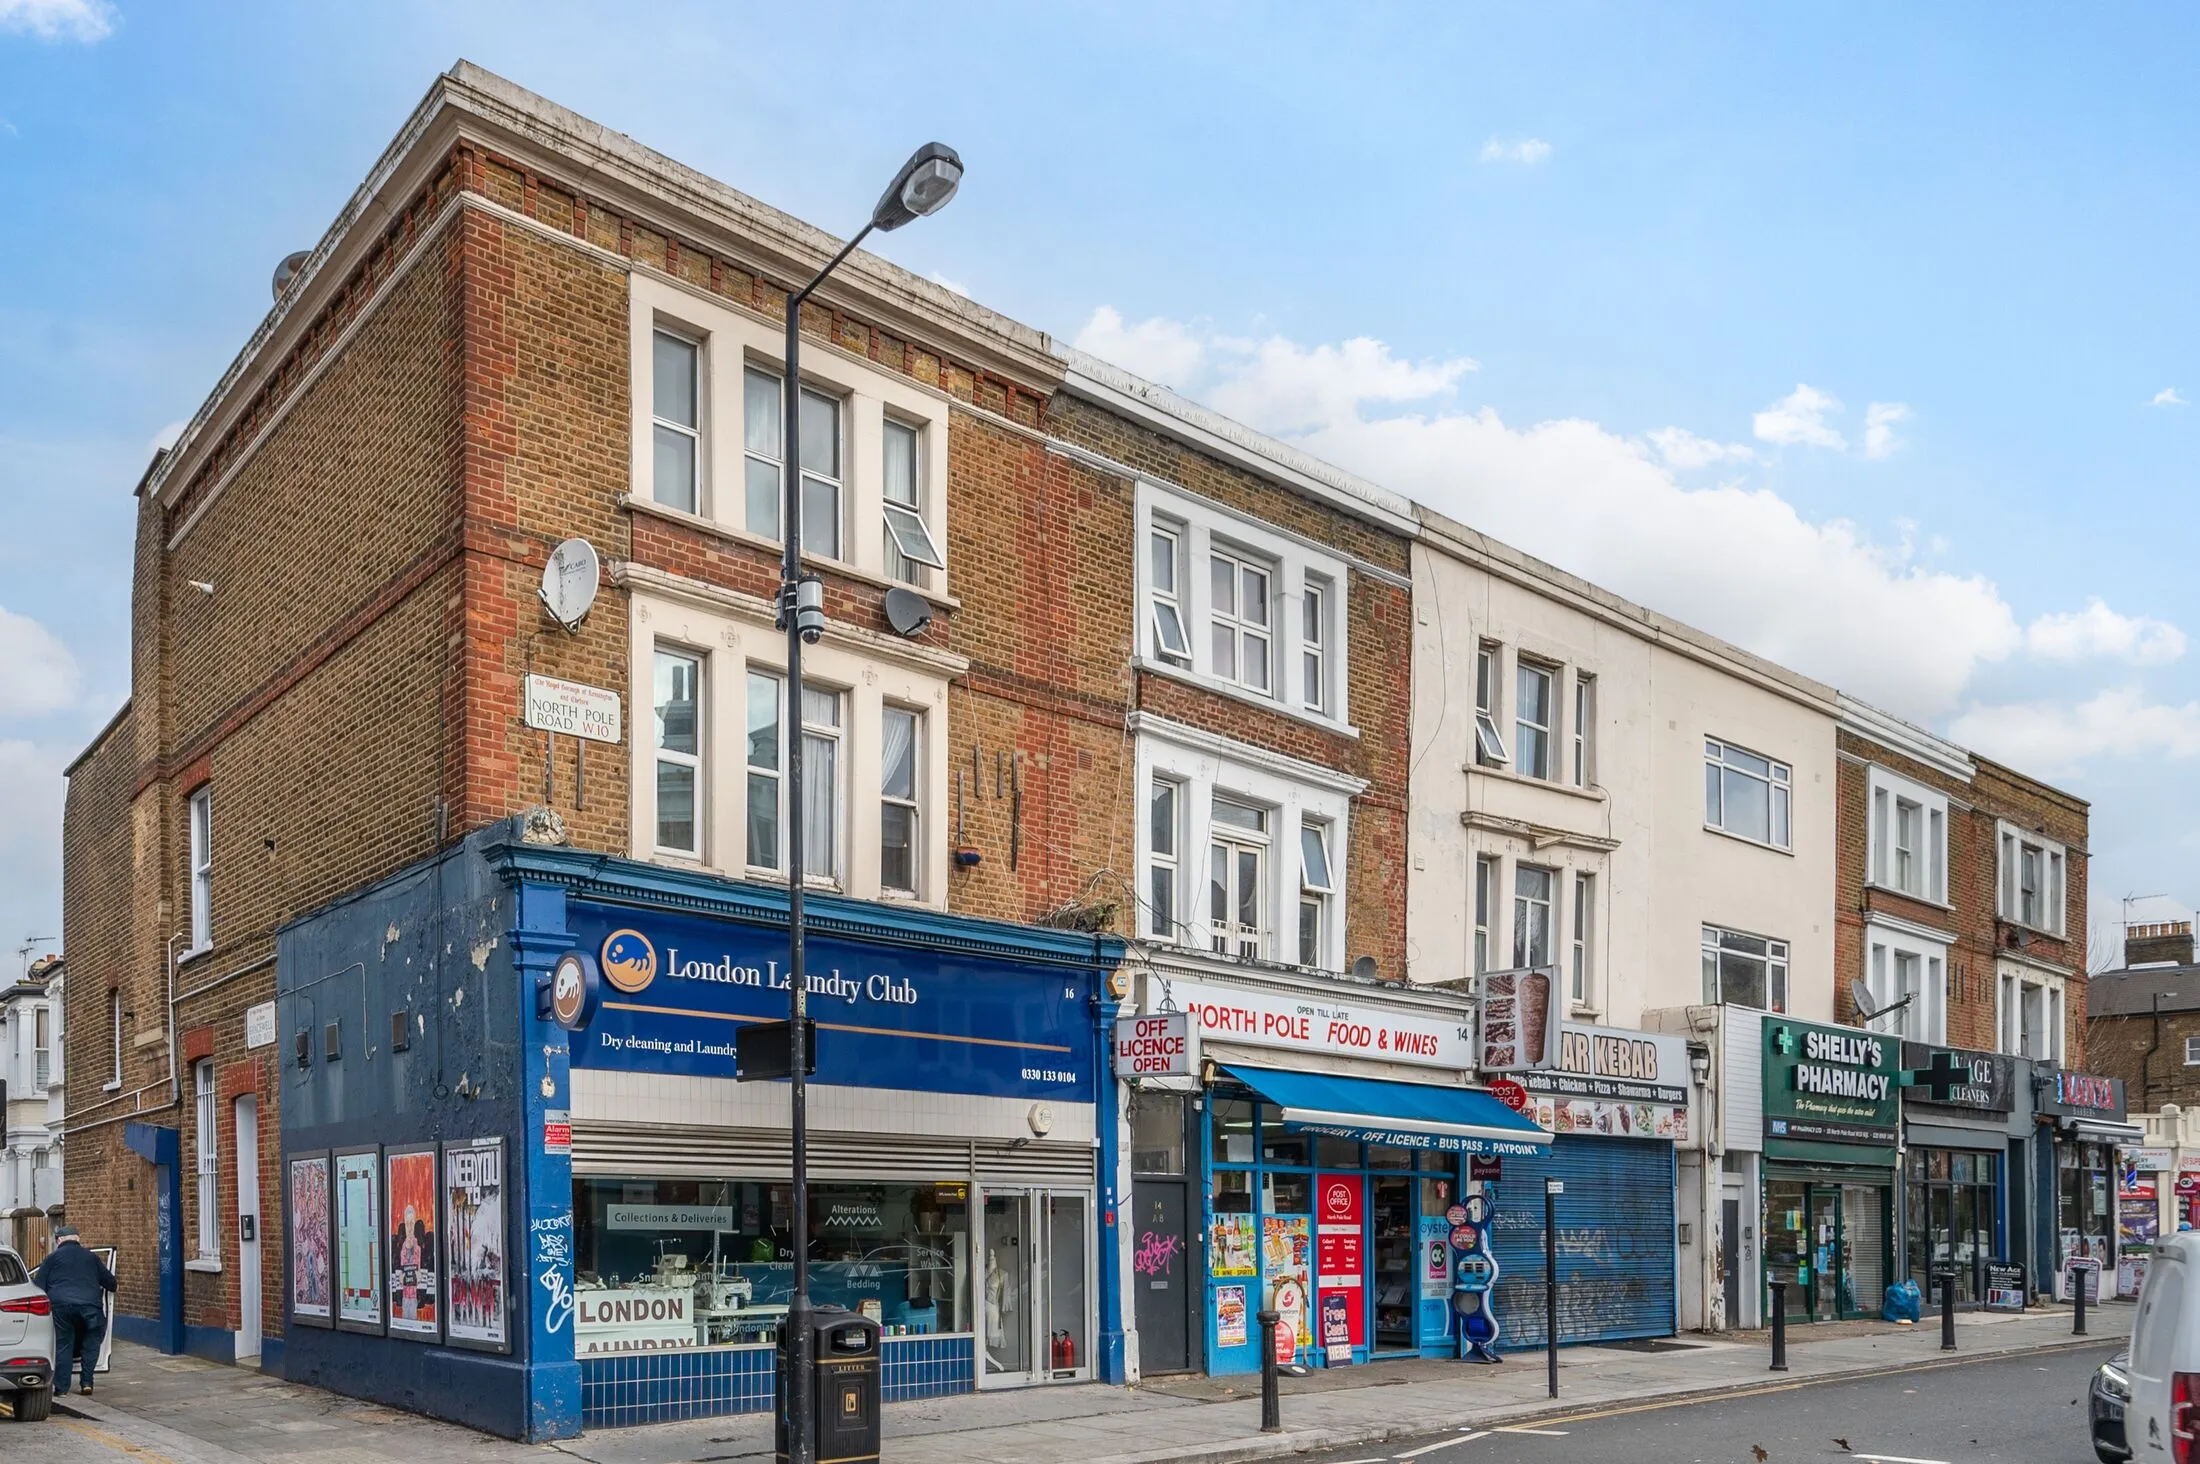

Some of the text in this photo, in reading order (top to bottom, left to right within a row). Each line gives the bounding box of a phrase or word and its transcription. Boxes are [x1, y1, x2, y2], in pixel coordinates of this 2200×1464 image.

[532, 698, 615, 726] NORTH POLE
[537, 712, 573, 730] ROAD
[666, 948, 918, 1005] London Laundry Club
[1064, 987, 1075, 999] 16
[1296, 1005, 1350, 1021] OPEN TILL LATE
[1135, 1018, 1169, 1038] OFF
[1188, 1002, 1438, 1057] NORTH POLE FOOD & WINES
[1456, 1027, 1469, 1042] 14
[601, 1032, 738, 1059] Dry cleaning and Laundry
[1119, 1036, 1185, 1058] LICENCE
[1806, 1030, 1882, 1068] SHELLY'S
[1560, 1031, 1659, 1081] AR KEBAB
[1132, 1056, 1171, 1073] OPEN
[1021, 1068, 1077, 1084] 0330 133 0104
[1796, 1063, 1890, 1101] PHARMACY
[1490, 1086, 1518, 1096] POST
[1558, 1077, 1588, 1093] Chicken
[1594, 1081, 1611, 1095] Pizza
[1617, 1082, 1652, 1099] Shawarma
[1657, 1086, 1684, 1103] Burgers
[1952, 1085, 1990, 1104] CLEANERS
[1498, 1096, 1521, 1106] FICE
[1795, 1098, 1805, 1110] The
[1804, 1099, 1828, 1116] Pharmacy
[1828, 1104, 1838, 1114] that
[545, 1125, 570, 1133] Alarm
[1771, 1120, 1787, 1135] NHS
[1300, 1124, 1539, 1156] GROCERY OFF LICENCE BUS PASS PAYPOINT
[1473, 1166, 1501, 1177] payzone
[1329, 1197, 1349, 1206] OFFICE
[1332, 1189, 1346, 1199] POST
[831, 1204, 877, 1216] Alterations
[1154, 1200, 1163, 1210] 14
[614, 1211, 728, 1225] Collections & Deliveries
[1420, 1221, 1448, 1237] oyste
[779, 1247, 795, 1260] Dry
[916, 1248, 945, 1259] Service
[769, 1261, 794, 1271] Clean
[919, 1259, 941, 1270] Wash
[846, 1279, 881, 1290] Bedding
[580, 1297, 684, 1323] LONDON
[1323, 1306, 1347, 1322] Free
[1324, 1320, 1349, 1337] Cash
[1327, 1343, 1353, 1361] HERE
[838, 1364, 866, 1372] LITTER
